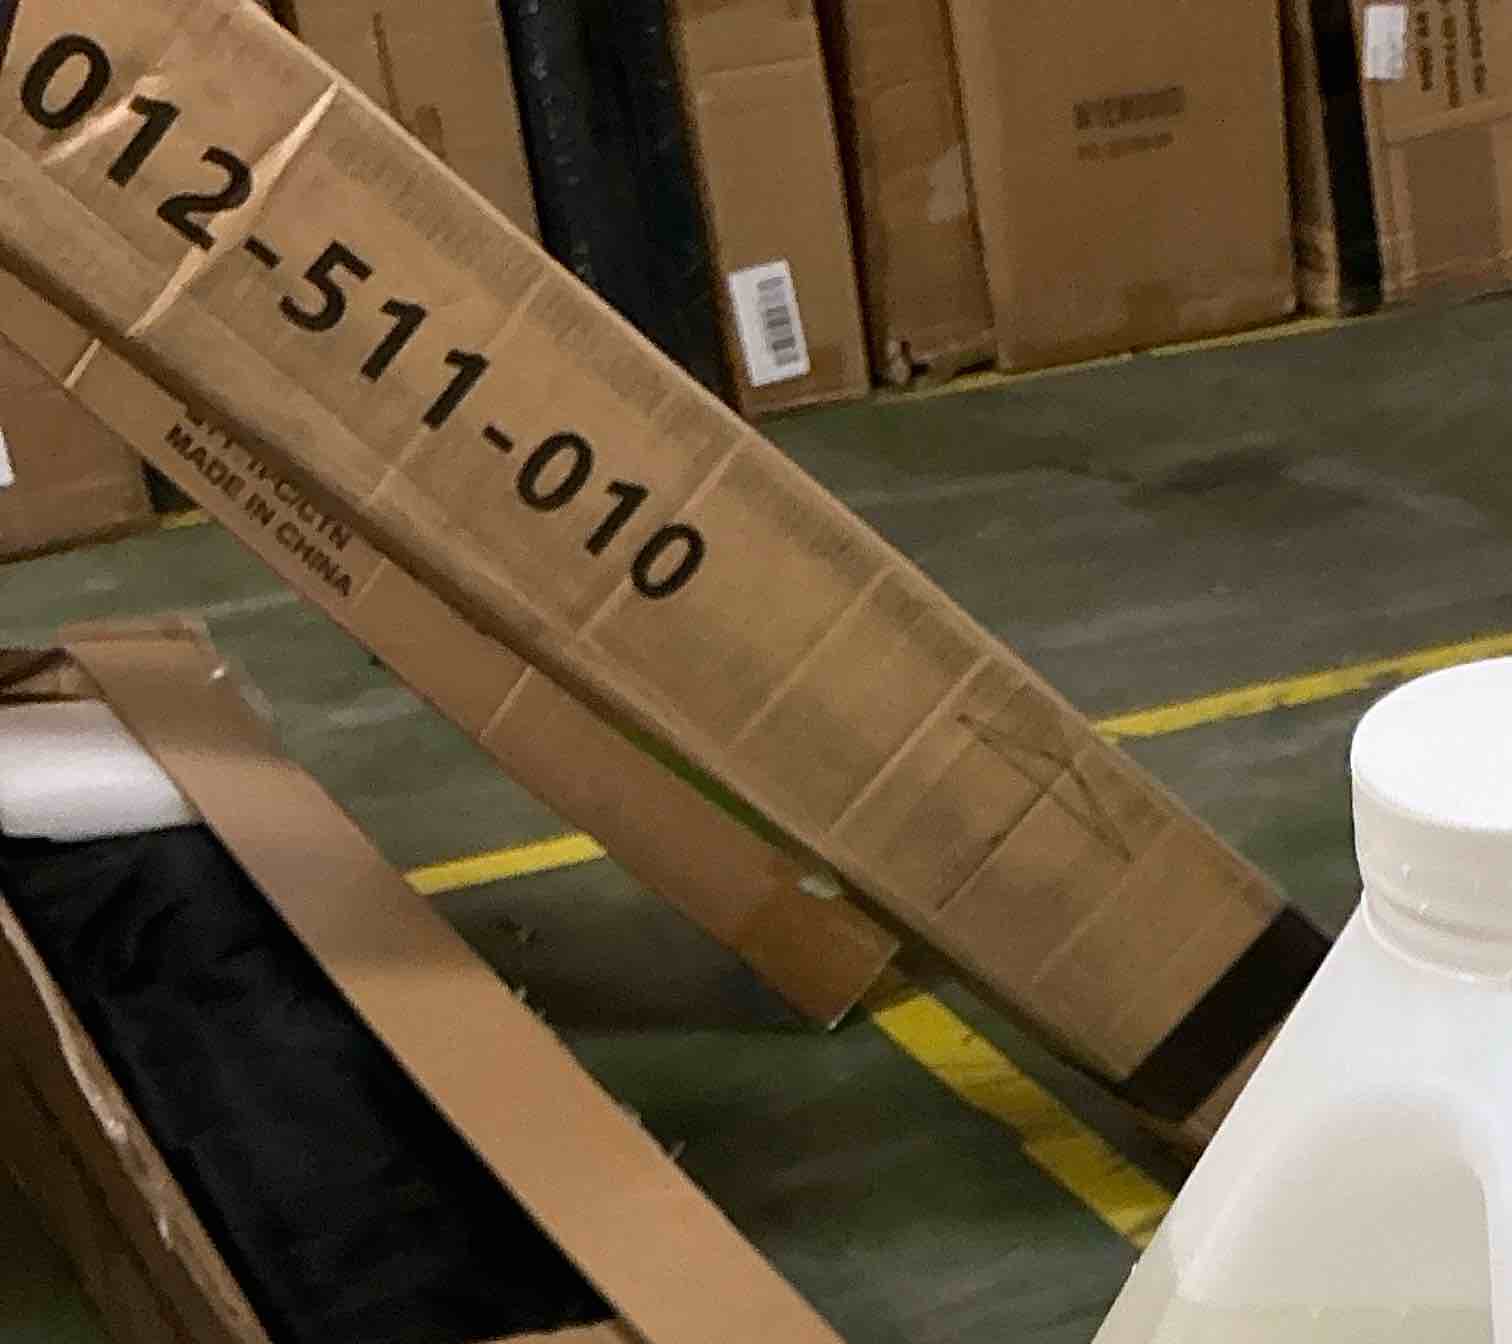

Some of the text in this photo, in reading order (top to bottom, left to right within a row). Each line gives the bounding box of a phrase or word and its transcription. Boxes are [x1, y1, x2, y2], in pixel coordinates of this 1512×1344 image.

[20, 34, 706, 600] 012-511-010
[165, 424, 352, 597] MADE IN CHINA
